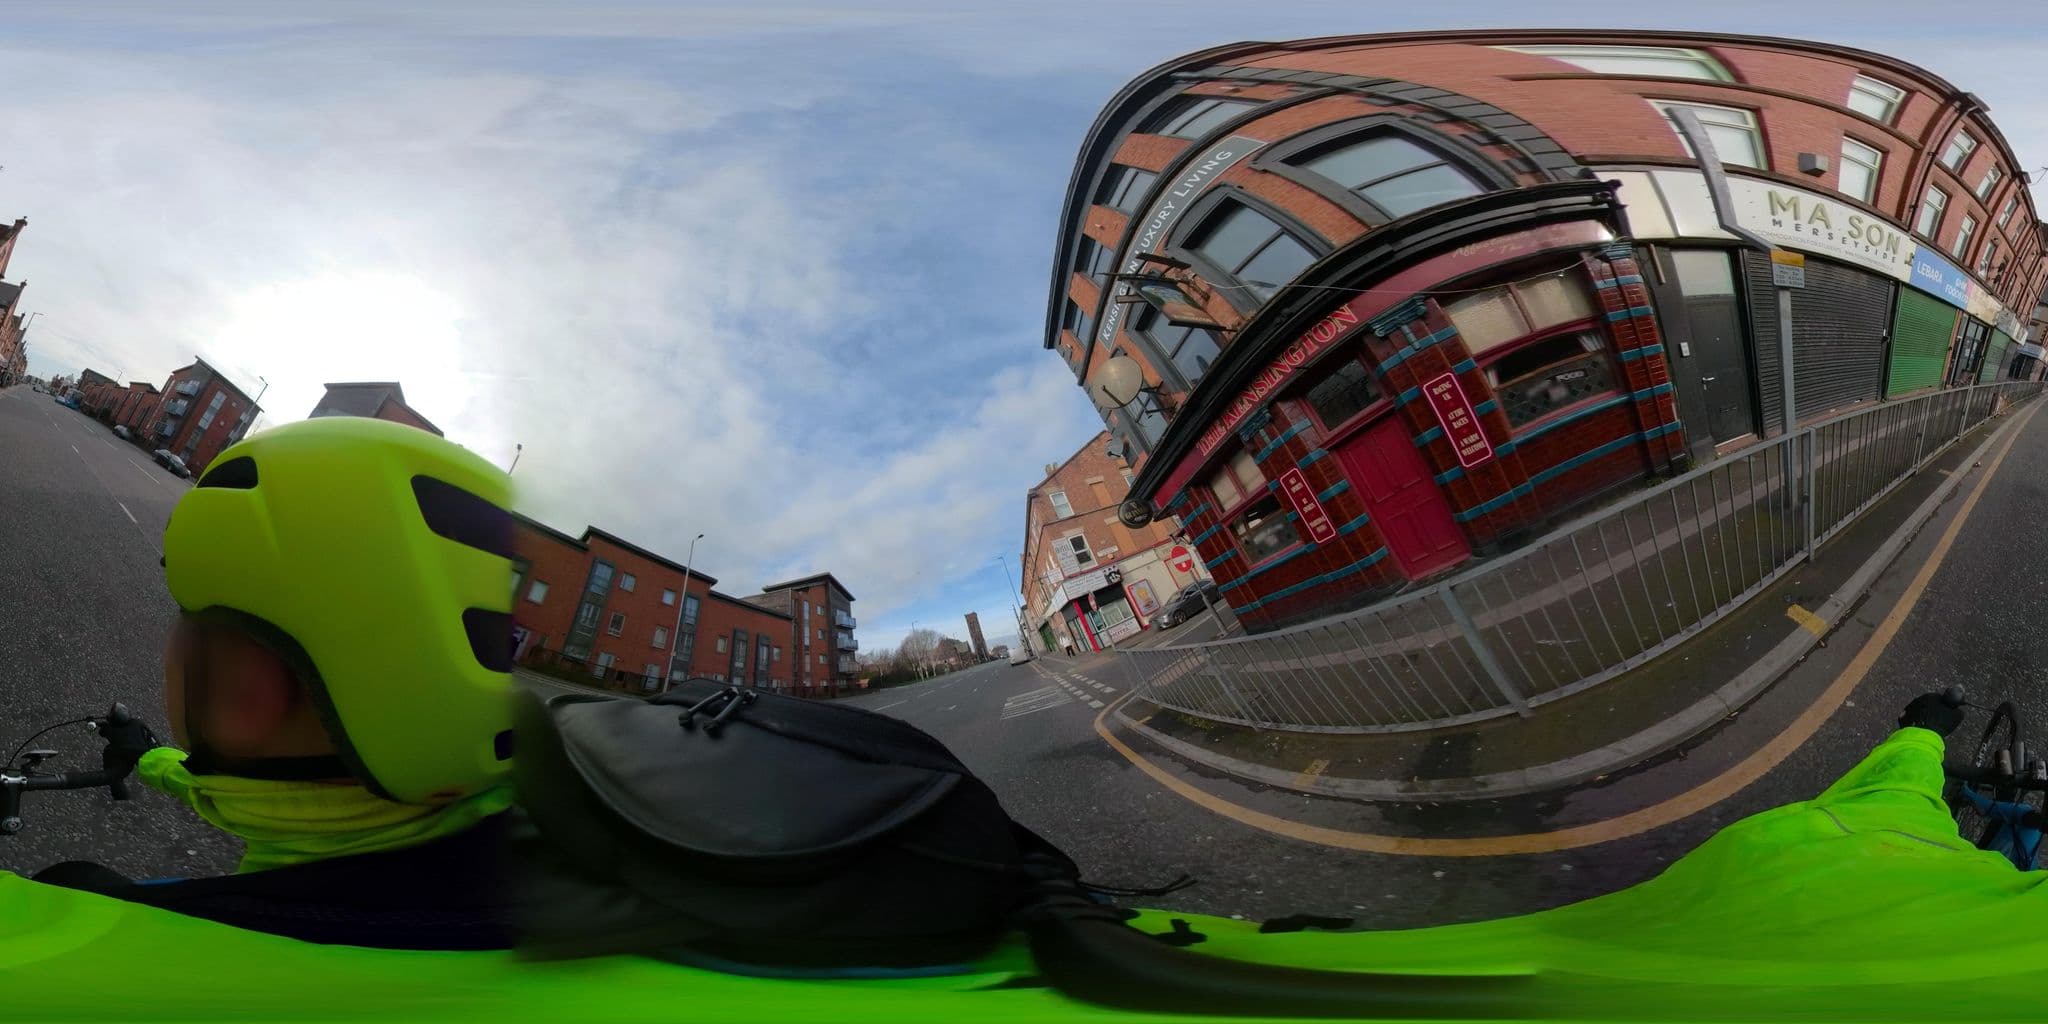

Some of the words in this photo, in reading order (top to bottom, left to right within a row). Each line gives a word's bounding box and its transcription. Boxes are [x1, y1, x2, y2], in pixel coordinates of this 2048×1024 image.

[1102, 260, 1139, 340] KENSIGN
[1174, 150, 1233, 197] LIVING
[1772, 218, 1897, 263] MERSEYSIDE
[1848, 215, 1901, 255] SON
[1917, 261, 1943, 283] LEBARA
[1220, 303, 1358, 431] KENSINGTON
[1461, 440, 1486, 457] WELCOME
